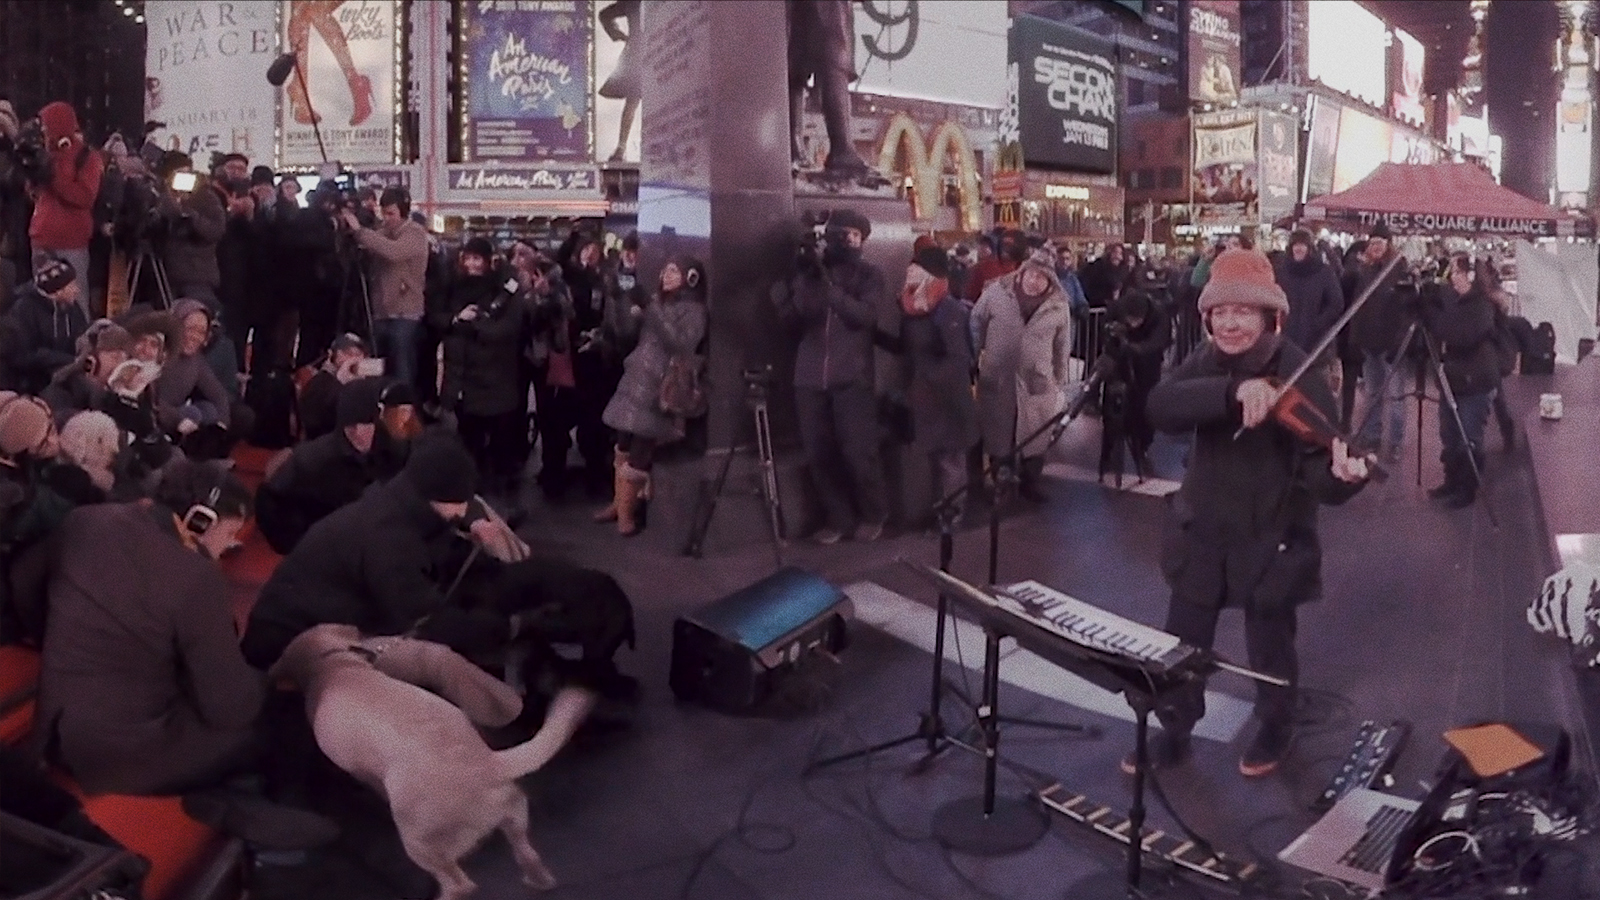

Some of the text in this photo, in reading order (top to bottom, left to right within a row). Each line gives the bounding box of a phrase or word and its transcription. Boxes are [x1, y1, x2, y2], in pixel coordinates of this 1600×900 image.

[166, 3, 237, 36] WAR
[159, 30, 269, 70] PEACE
[504, 32, 527, 59] An
[489, 50, 571, 84] American
[1034, 56, 1115, 99] SECON
[1358, 210, 1548, 235] TIMES SQUARE ALLIANCE
